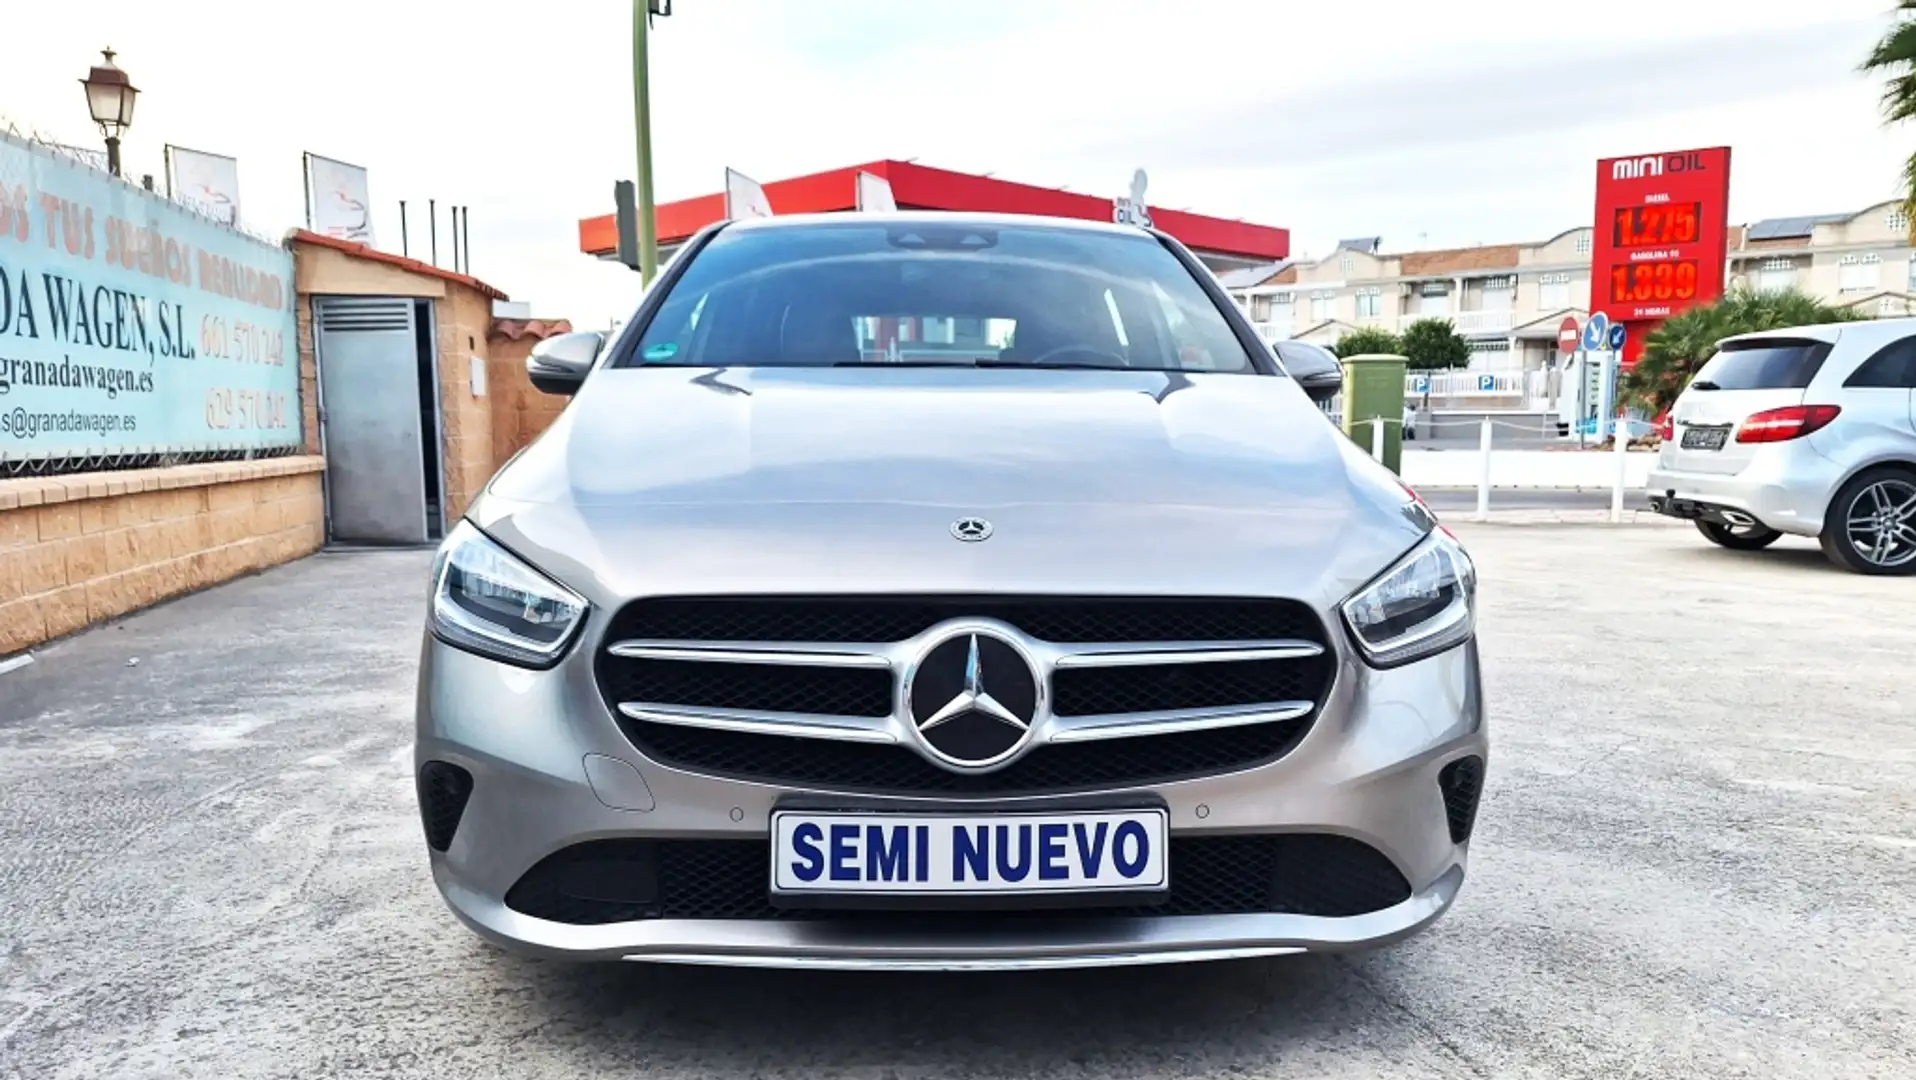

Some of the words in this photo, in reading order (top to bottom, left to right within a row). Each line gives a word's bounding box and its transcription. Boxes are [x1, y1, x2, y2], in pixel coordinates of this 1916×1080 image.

[1668, 153, 1706, 172] OIL
[37, 190, 94, 260] TUS
[42, 272, 155, 366] WAGEN,
[159, 299, 196, 360] S.L.
[791, 822, 929, 883] SEMI
[952, 820, 1149, 883] NUEVO
